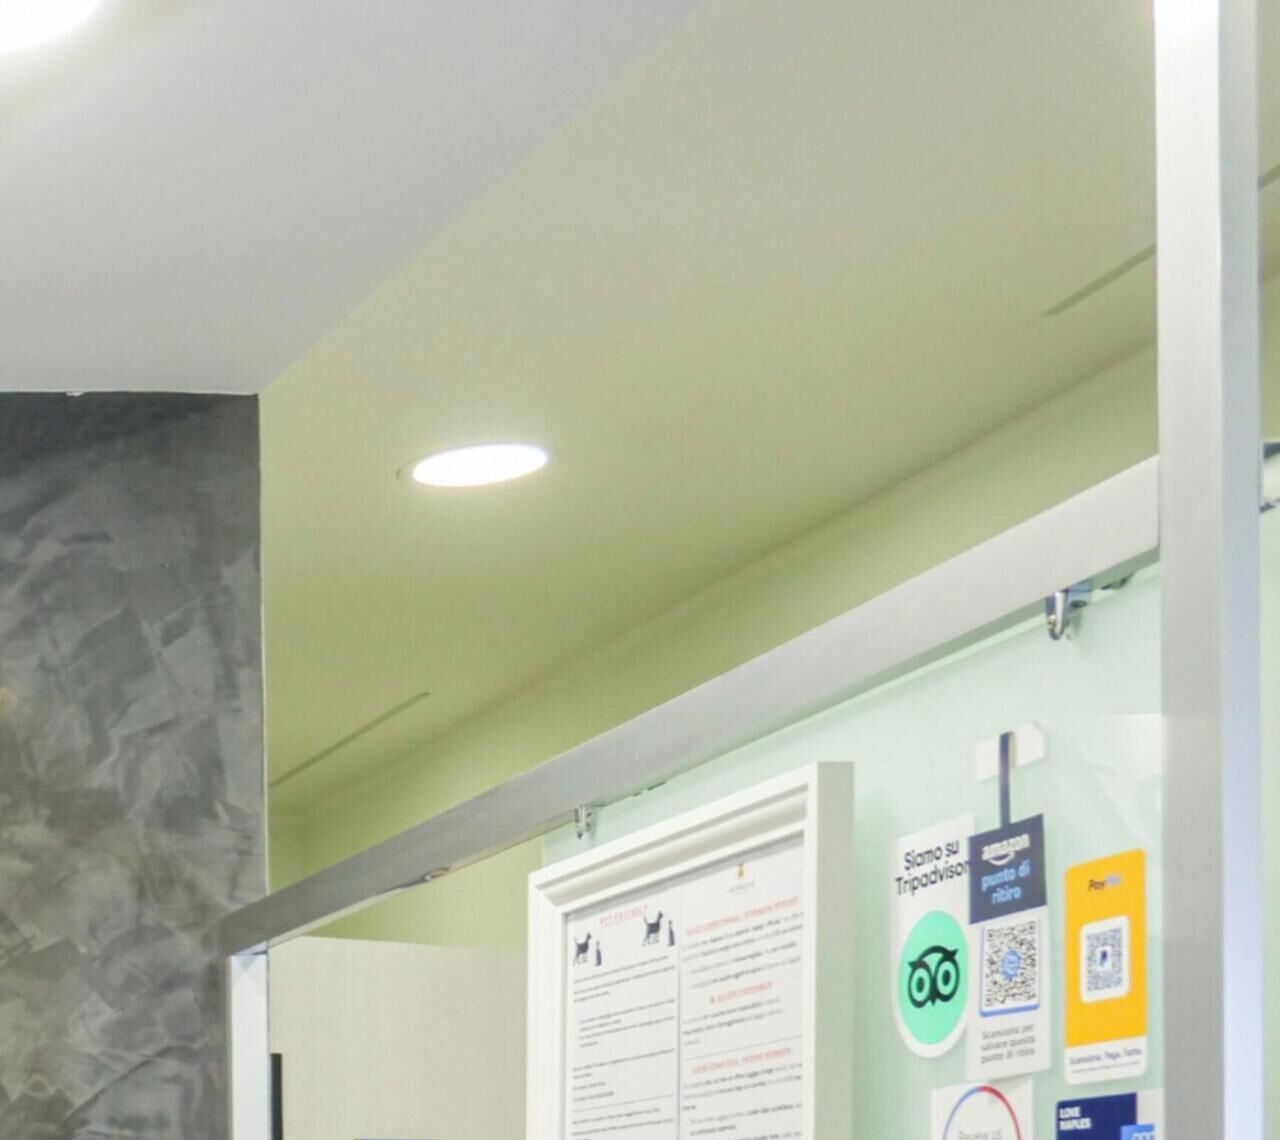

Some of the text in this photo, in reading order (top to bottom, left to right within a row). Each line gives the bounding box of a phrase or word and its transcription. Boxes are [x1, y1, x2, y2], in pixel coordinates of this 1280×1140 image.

[904, 840, 960, 871] Siamo su
[896, 860, 968, 896] Tripadvisor
[982, 859, 1030, 892] punto di
[992, 885, 1022, 904] ritiro
